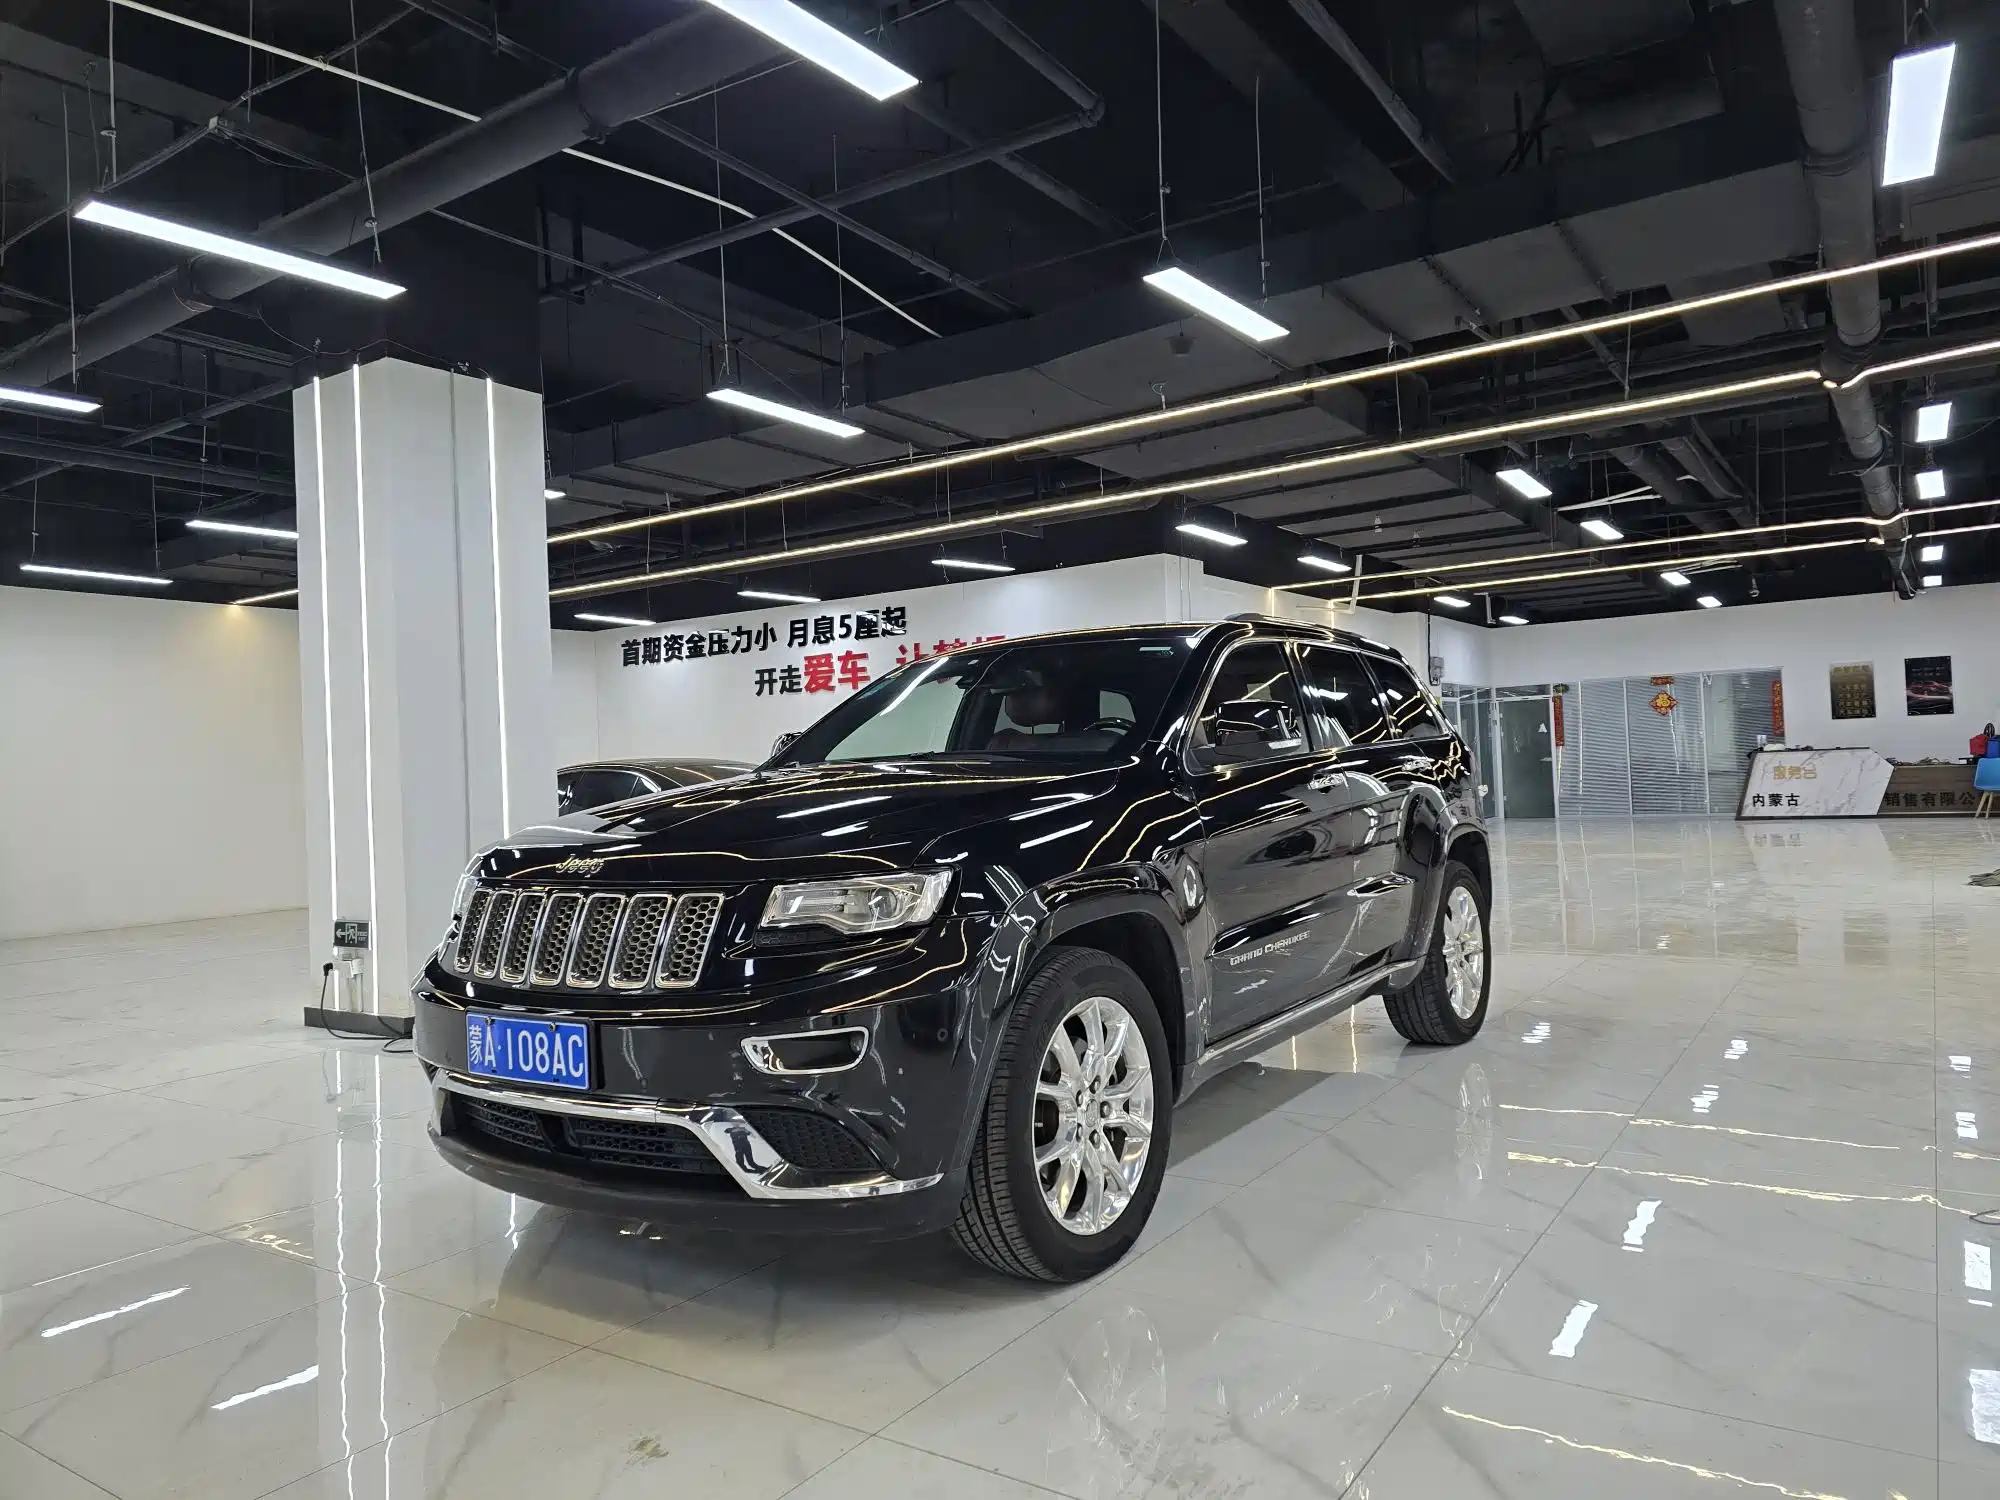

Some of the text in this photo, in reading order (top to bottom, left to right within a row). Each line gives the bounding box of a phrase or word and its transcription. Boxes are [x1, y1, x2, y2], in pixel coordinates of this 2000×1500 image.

[621, 606, 907, 667] 首期资金压力小 月息5厘起
[755, 650, 871, 696] 开走爱车
[1752, 792, 1801, 807] 内蒙古
[555, 853, 605, 878] Jeep
[1230, 947, 1263, 966] GRAND
